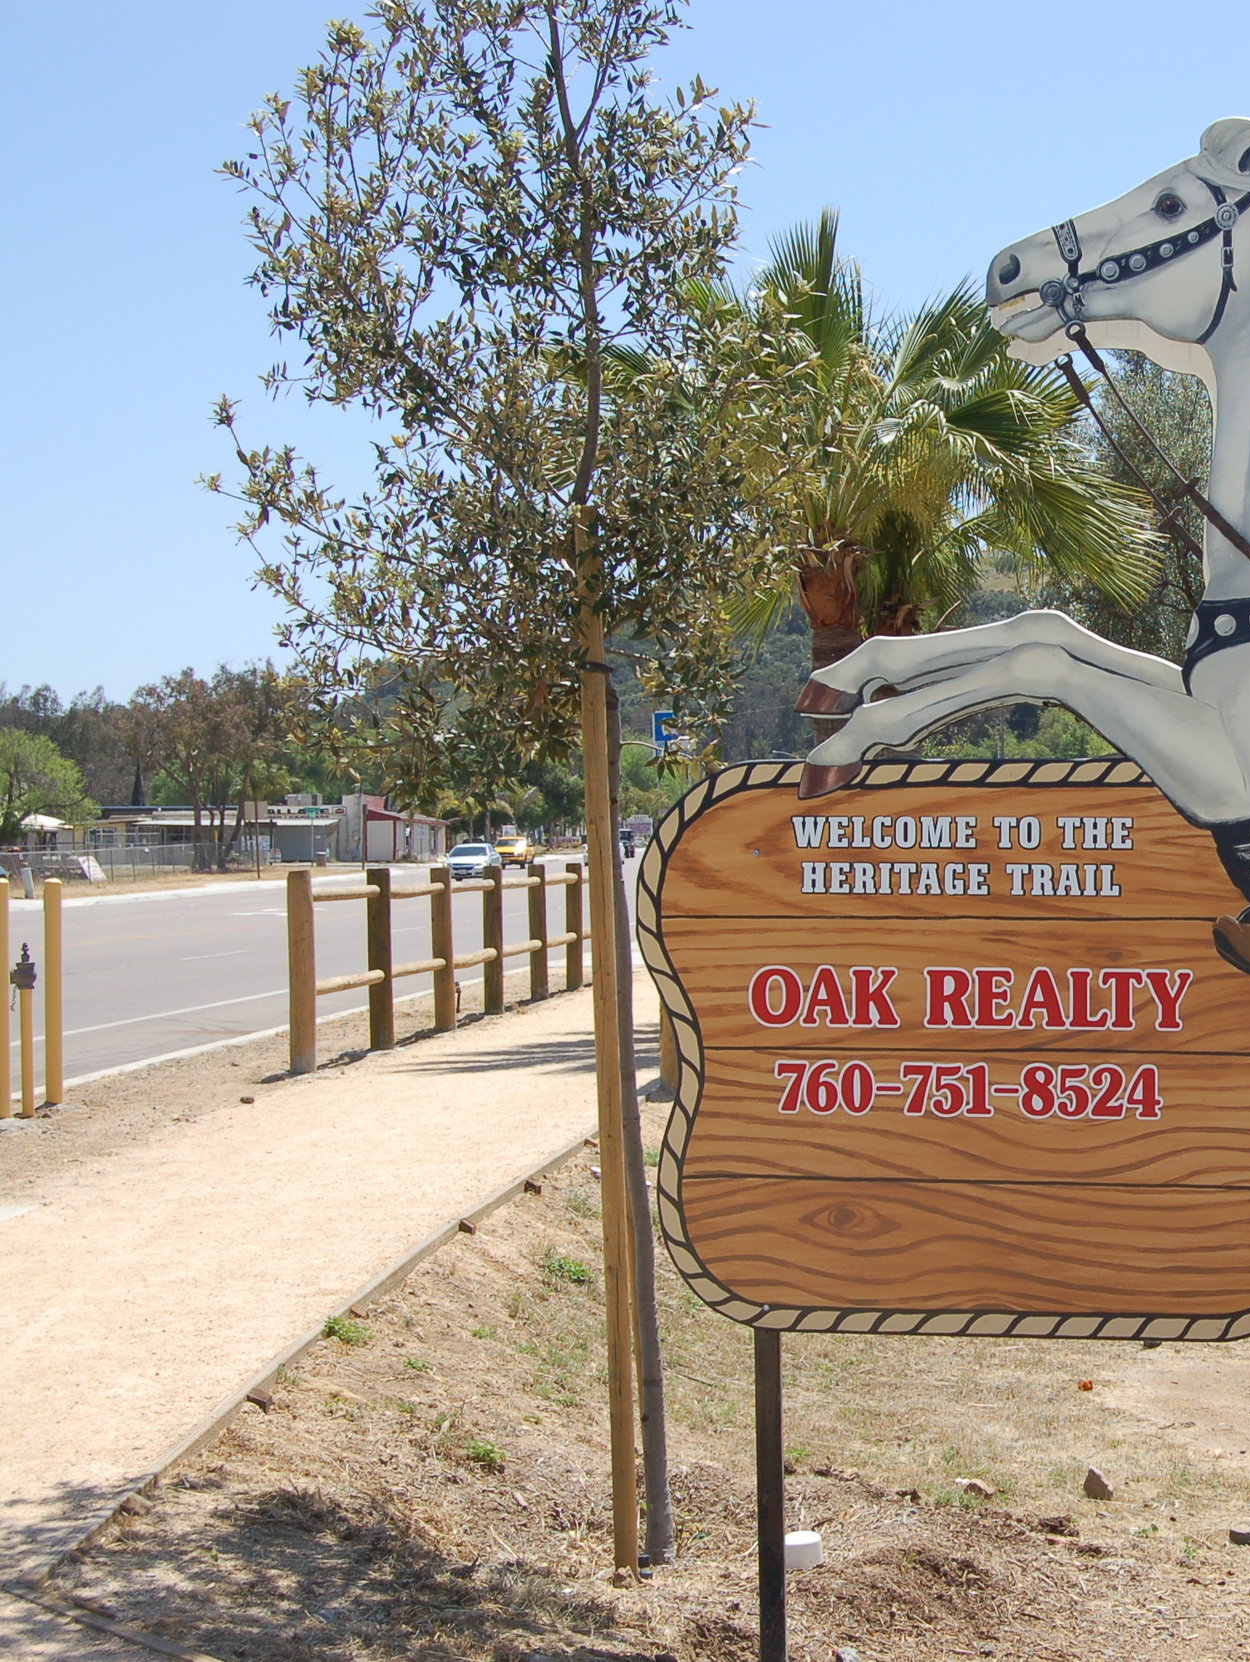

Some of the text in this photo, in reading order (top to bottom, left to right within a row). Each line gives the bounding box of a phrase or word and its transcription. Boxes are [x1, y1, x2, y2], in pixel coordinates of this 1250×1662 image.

[791, 816, 1134, 850] WELCOME TO THE
[801, 862, 1121, 897] HERITAGE TRAIL
[748, 964, 1194, 1031] OAK REALTY
[774, 1059, 1164, 1120] 760-751-8524
